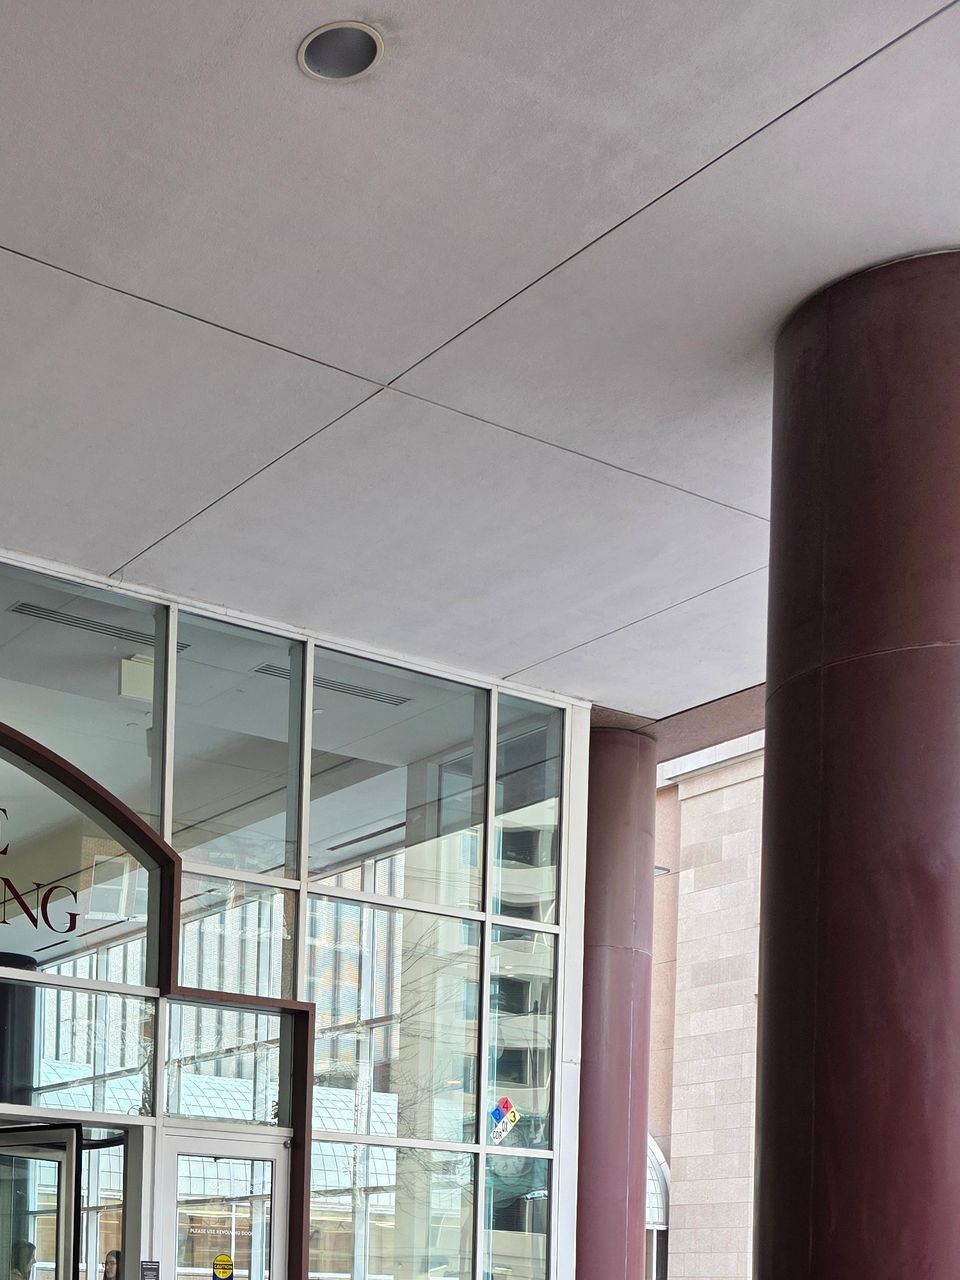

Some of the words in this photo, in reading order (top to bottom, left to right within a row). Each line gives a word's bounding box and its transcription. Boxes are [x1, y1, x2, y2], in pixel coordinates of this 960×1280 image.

[503, 1100, 509, 1111] 4
[495, 1108, 501, 1121] 3
[510, 1111, 516, 1123] 3
